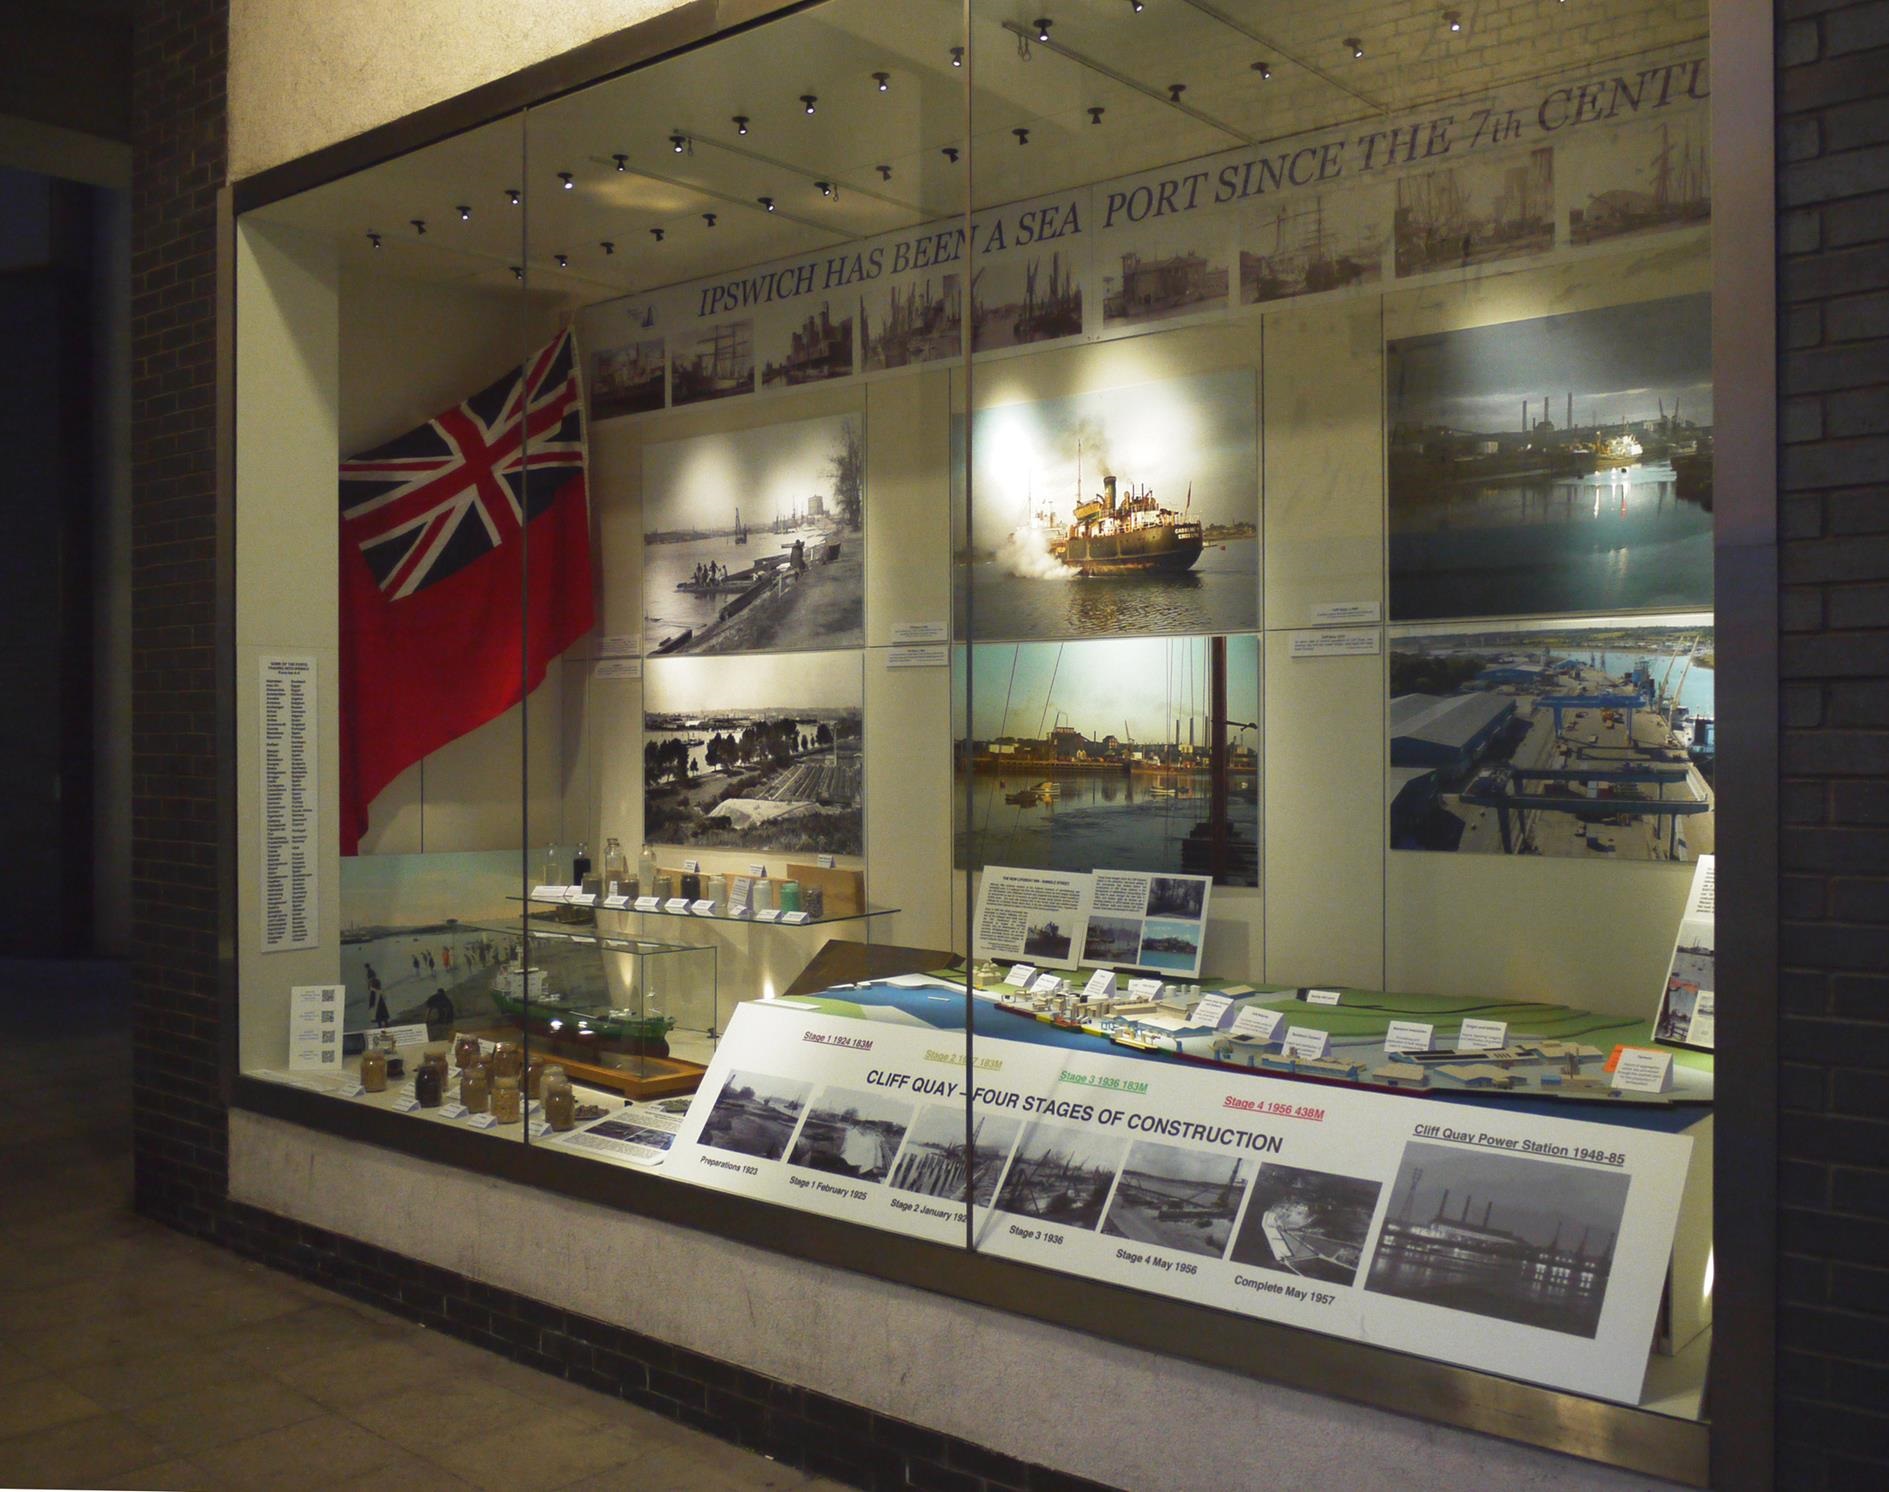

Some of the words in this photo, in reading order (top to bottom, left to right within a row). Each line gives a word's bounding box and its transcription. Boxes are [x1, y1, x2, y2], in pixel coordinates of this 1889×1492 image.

[698, 263, 817, 317] IPSWICH
[822, 248, 885, 289] HAS
[890, 225, 980, 274] BEEN
[982, 218, 1007, 254] A
[1015, 201, 1082, 246] SEA
[1102, 172, 1209, 229] PORT
[1214, 142, 1346, 204] SINCE
[1357, 115, 1457, 174] THE
[1468, 108, 1522, 149] 7th
[803, 1030, 826, 1042] Stage
[826, 1035, 832, 1043] 1
[833, 1036, 851, 1046] 1924
[852, 1038, 874, 1049] 183M
[925, 1049, 949, 1061] Stage
[950, 1054, 957, 1062] 2
[1058, 1070, 1088, 1085] Stage
[1089, 1075, 1096, 1084] 3
[1098, 1076, 1120, 1088] 1936
[1122, 1078, 1149, 1092] 183M
[866, 1069, 910, 1088] CLIFF
[912, 1077, 958, 1098] QUAY
[972, 1087, 1020, 1109] FOUR
[1022, 1096, 1094, 1122] STAGES
[1098, 1108, 1125, 1126] OF
[1127, 1113, 1283, 1153] CONSTRUCTION
[1223, 1095, 1255, 1111] Stage
[1257, 1100, 1265, 1110] 4
[1267, 1101, 1293, 1115] 1956
[1296, 1106, 1325, 1120] 438M
[1414, 1123, 1440, 1136] Cliff
[1443, 1127, 1475, 1144] Quay
[1478, 1133, 1519, 1149] Power
[1521, 1139, 1569, 1156] Station
[1572, 1147, 1626, 1164] 1948-85
[700, 1155, 741, 1173] Preparations
[742, 1164, 758, 1176] 1923
[789, 1175, 810, 1189] Stage
[811, 1181, 816, 1190] 1
[816, 1181, 850, 1198] February
[850, 1188, 868, 1201] 1925
[890, 1198, 912, 1212] Stage
[912, 1203, 920, 1213] 2
[920, 1205, 952, 1222] January
[1009, 1225, 1034, 1241] Stage
[1034, 1230, 1042, 1240] 3
[1043, 1232, 1064, 1245] 1936
[1115, 1248, 1143, 1265] Stage
[1144, 1254, 1152, 1264] 4
[1152, 1257, 1173, 1272] May
[1174, 1262, 1198, 1276] 1956
[1234, 1274, 1283, 1295] Complete
[1284, 1286, 1308, 1301] May
[1309, 1290, 1336, 1306] 1957
